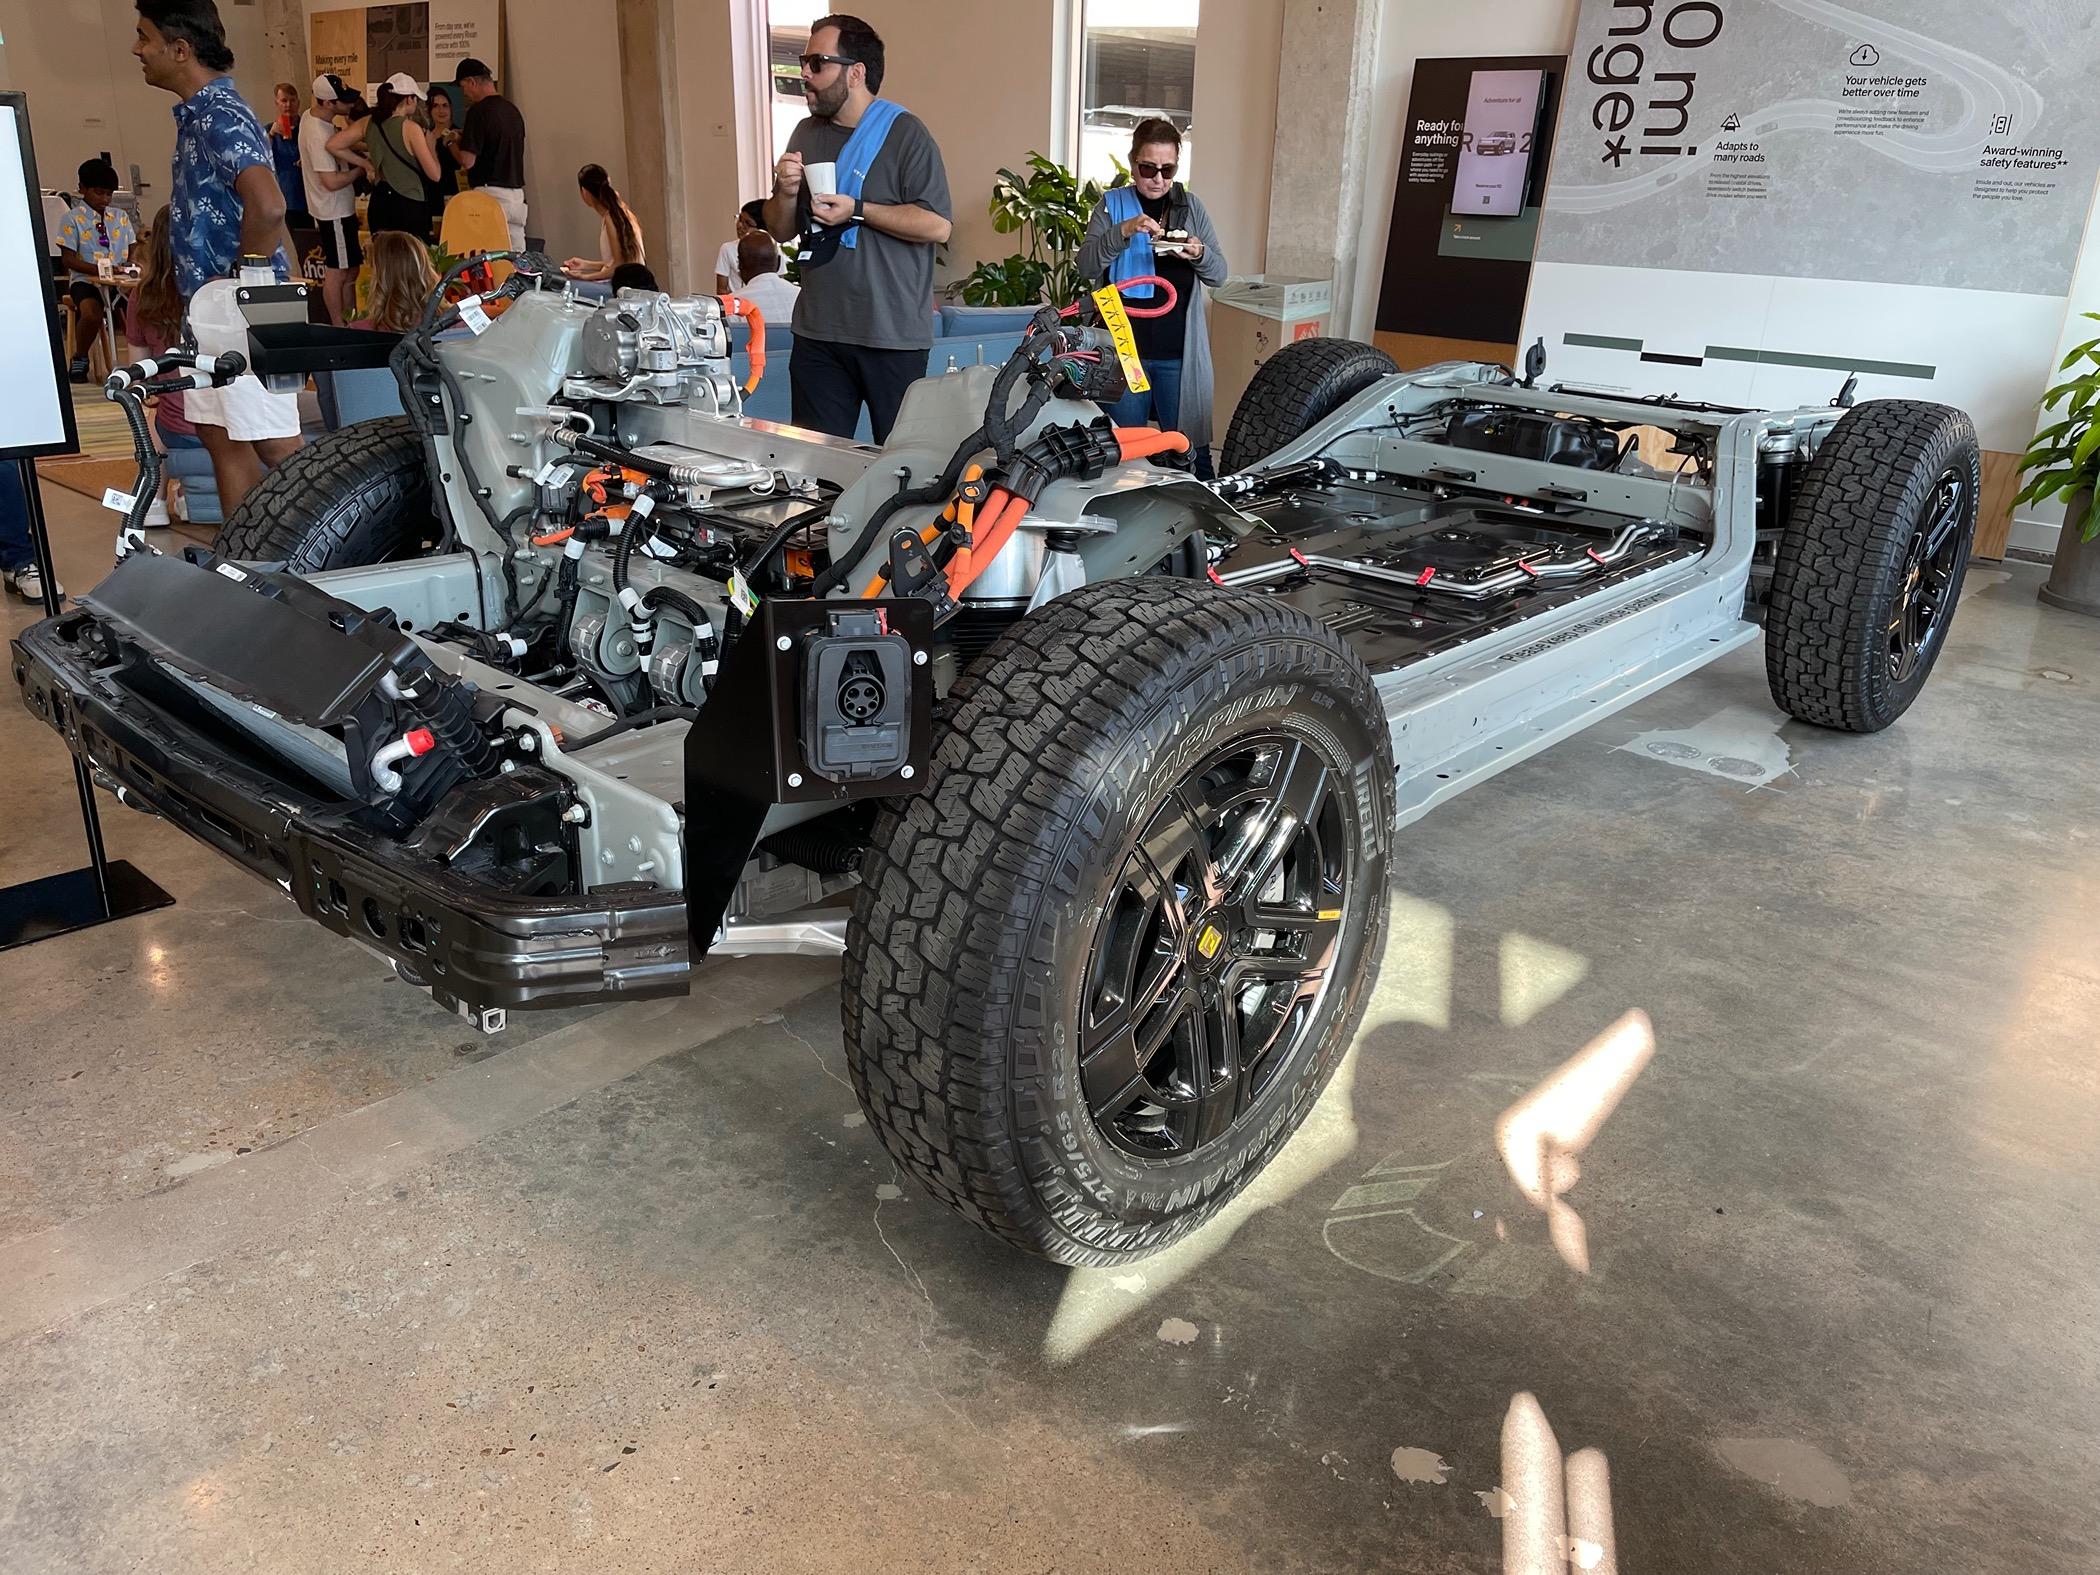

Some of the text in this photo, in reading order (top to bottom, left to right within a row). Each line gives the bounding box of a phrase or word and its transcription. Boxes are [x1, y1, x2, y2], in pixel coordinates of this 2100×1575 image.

[1846, 76, 1927, 87] Your vehicle gets
[1842, 88, 1872, 96] better
[1897, 88, 1920, 97] time
[1640, 73, 1698, 156] mi
[1417, 120, 1449, 133] Ready
[1414, 133, 1459, 147] anything
[1716, 142, 1748, 151] Adapts
[1714, 154, 1765, 163] many roads
[1982, 145, 2062, 160] Award-winning
[1980, 157, 2012, 169] safety
[1500, 593, 1671, 662] Please keep off vehicle platform
[1052, 1022, 1066, 1100] R20
[1165, 1082, 1307, 1214] TERRAIN
[1056, 1110, 1114, 1202] 275/65
